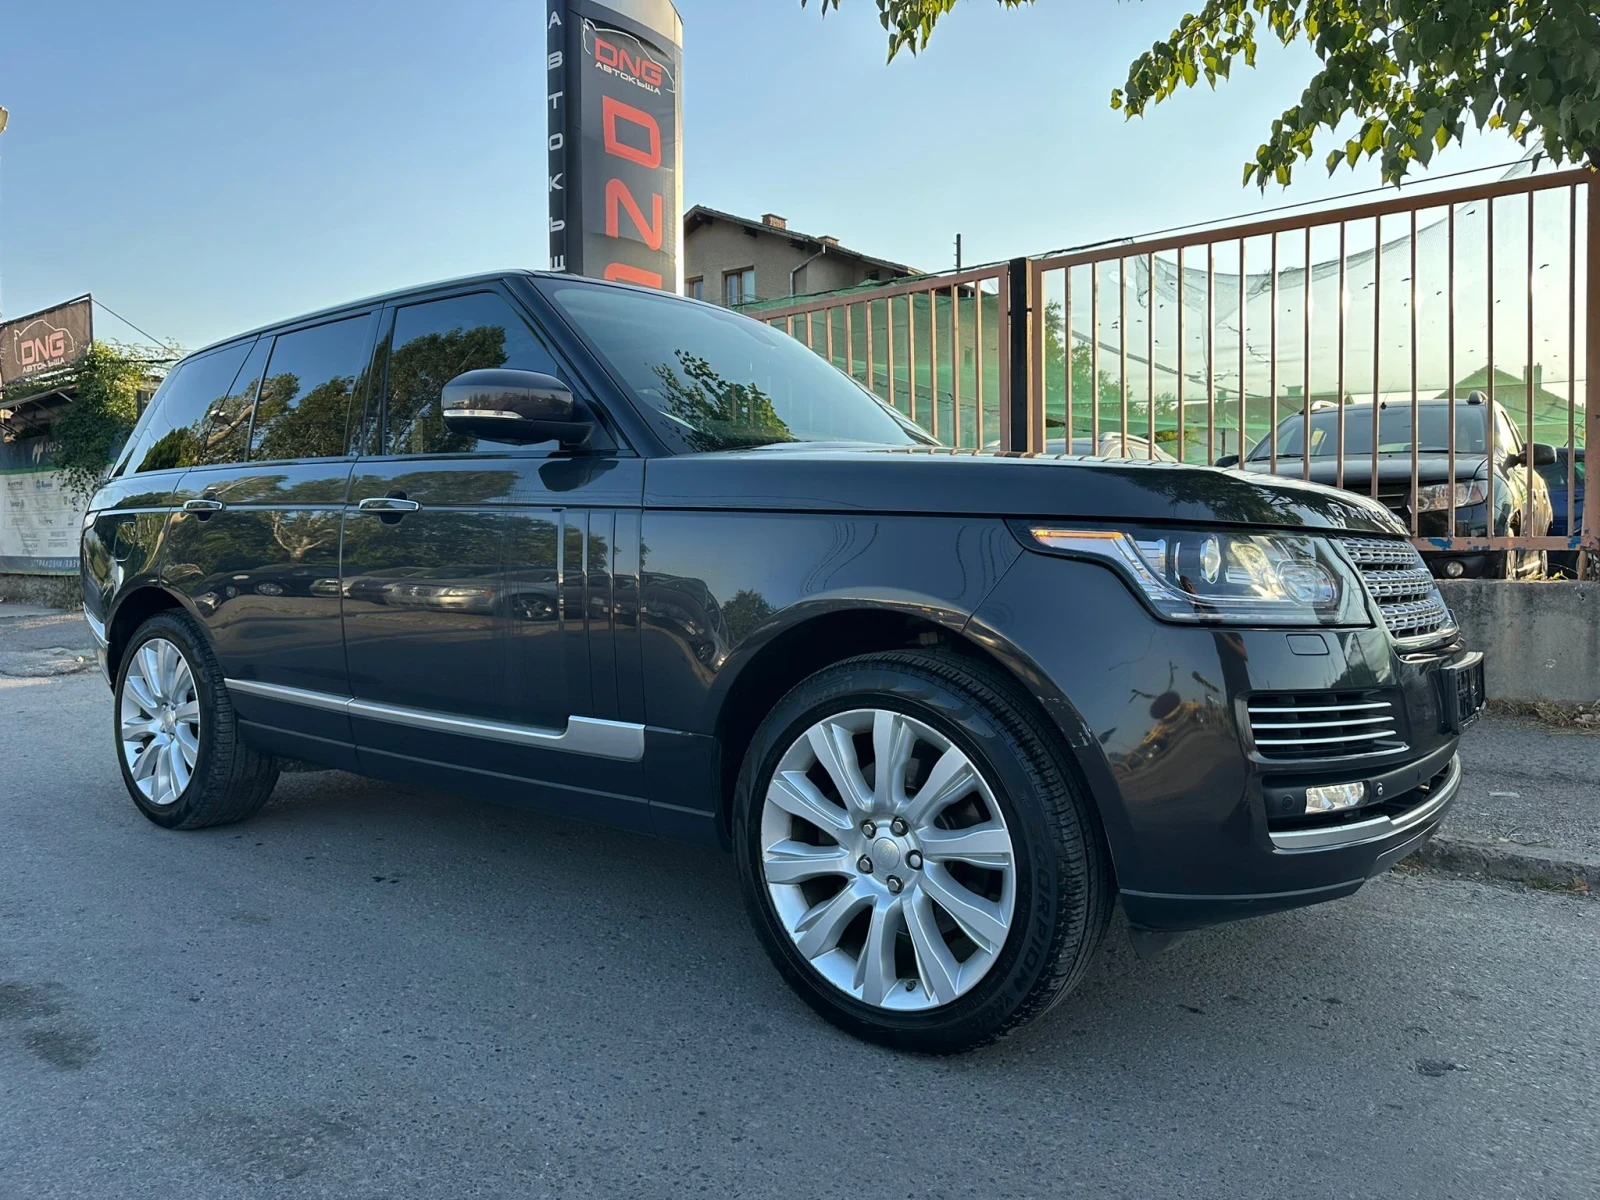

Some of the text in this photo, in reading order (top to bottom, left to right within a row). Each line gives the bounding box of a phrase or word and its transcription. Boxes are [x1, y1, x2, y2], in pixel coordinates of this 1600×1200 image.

[594, 37, 662, 87] DNG
[595, 61, 661, 95] АВТОКЪША
[20, 331, 65, 365] DNG
